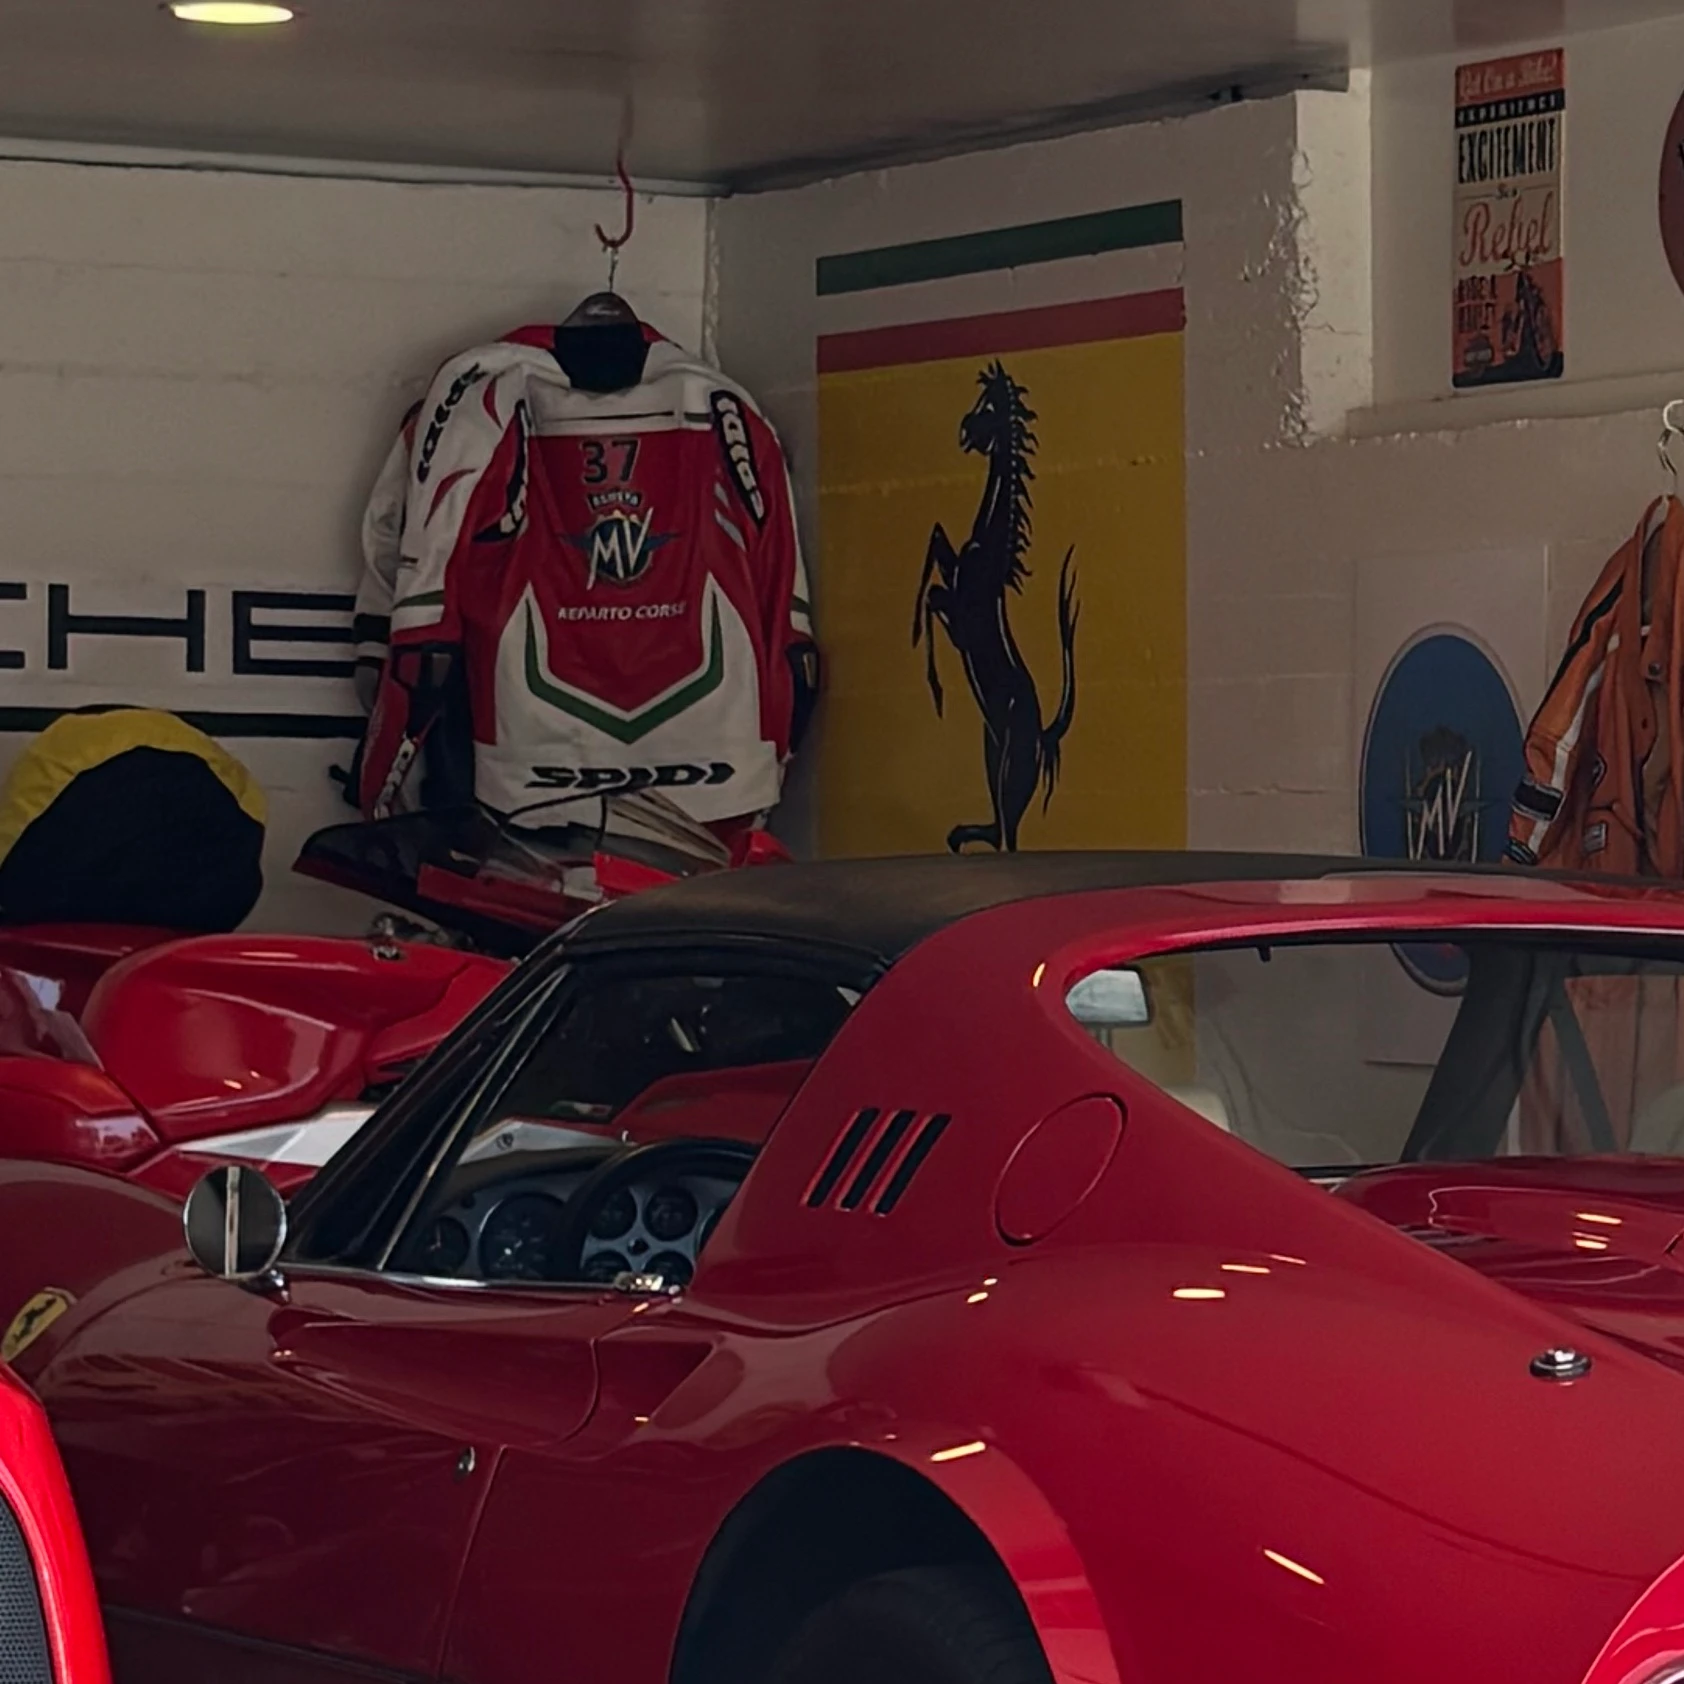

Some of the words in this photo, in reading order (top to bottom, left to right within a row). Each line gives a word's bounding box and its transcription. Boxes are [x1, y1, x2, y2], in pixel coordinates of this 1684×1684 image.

[1458, 118, 1556, 185] EXCITEMENT
[581, 439, 641, 485] 37
[586, 506, 654, 592] MV
[0, 582, 357, 678] HE
[557, 606, 632, 622] REPARTO
[635, 602, 686, 621] CORSE
[523, 762, 736, 789] SPIDI
